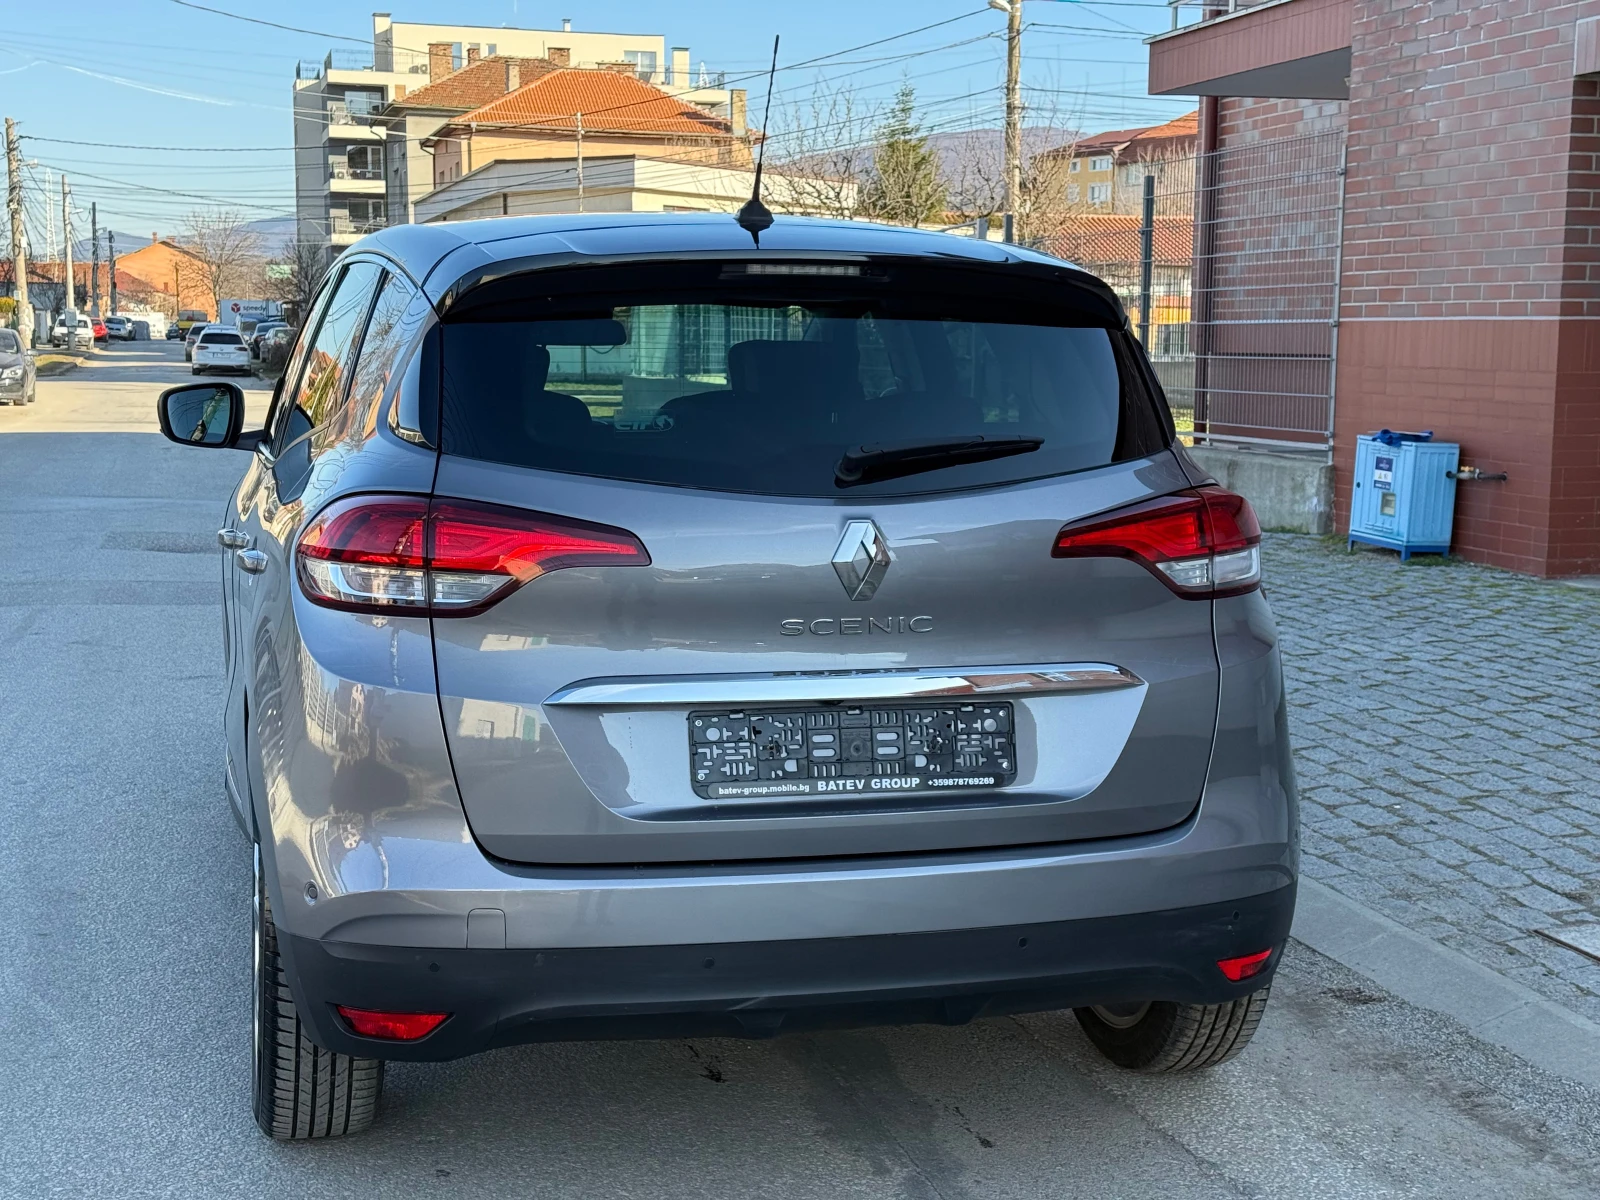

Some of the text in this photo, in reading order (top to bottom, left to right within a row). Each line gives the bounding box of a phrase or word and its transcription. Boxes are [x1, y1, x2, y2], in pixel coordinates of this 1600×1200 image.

[243, 304, 267, 312] speedy
[780, 615, 933, 636] SCENIC
[718, 776, 995, 795] batev-group.mobile.bg BATEV GROUP +359878769269
